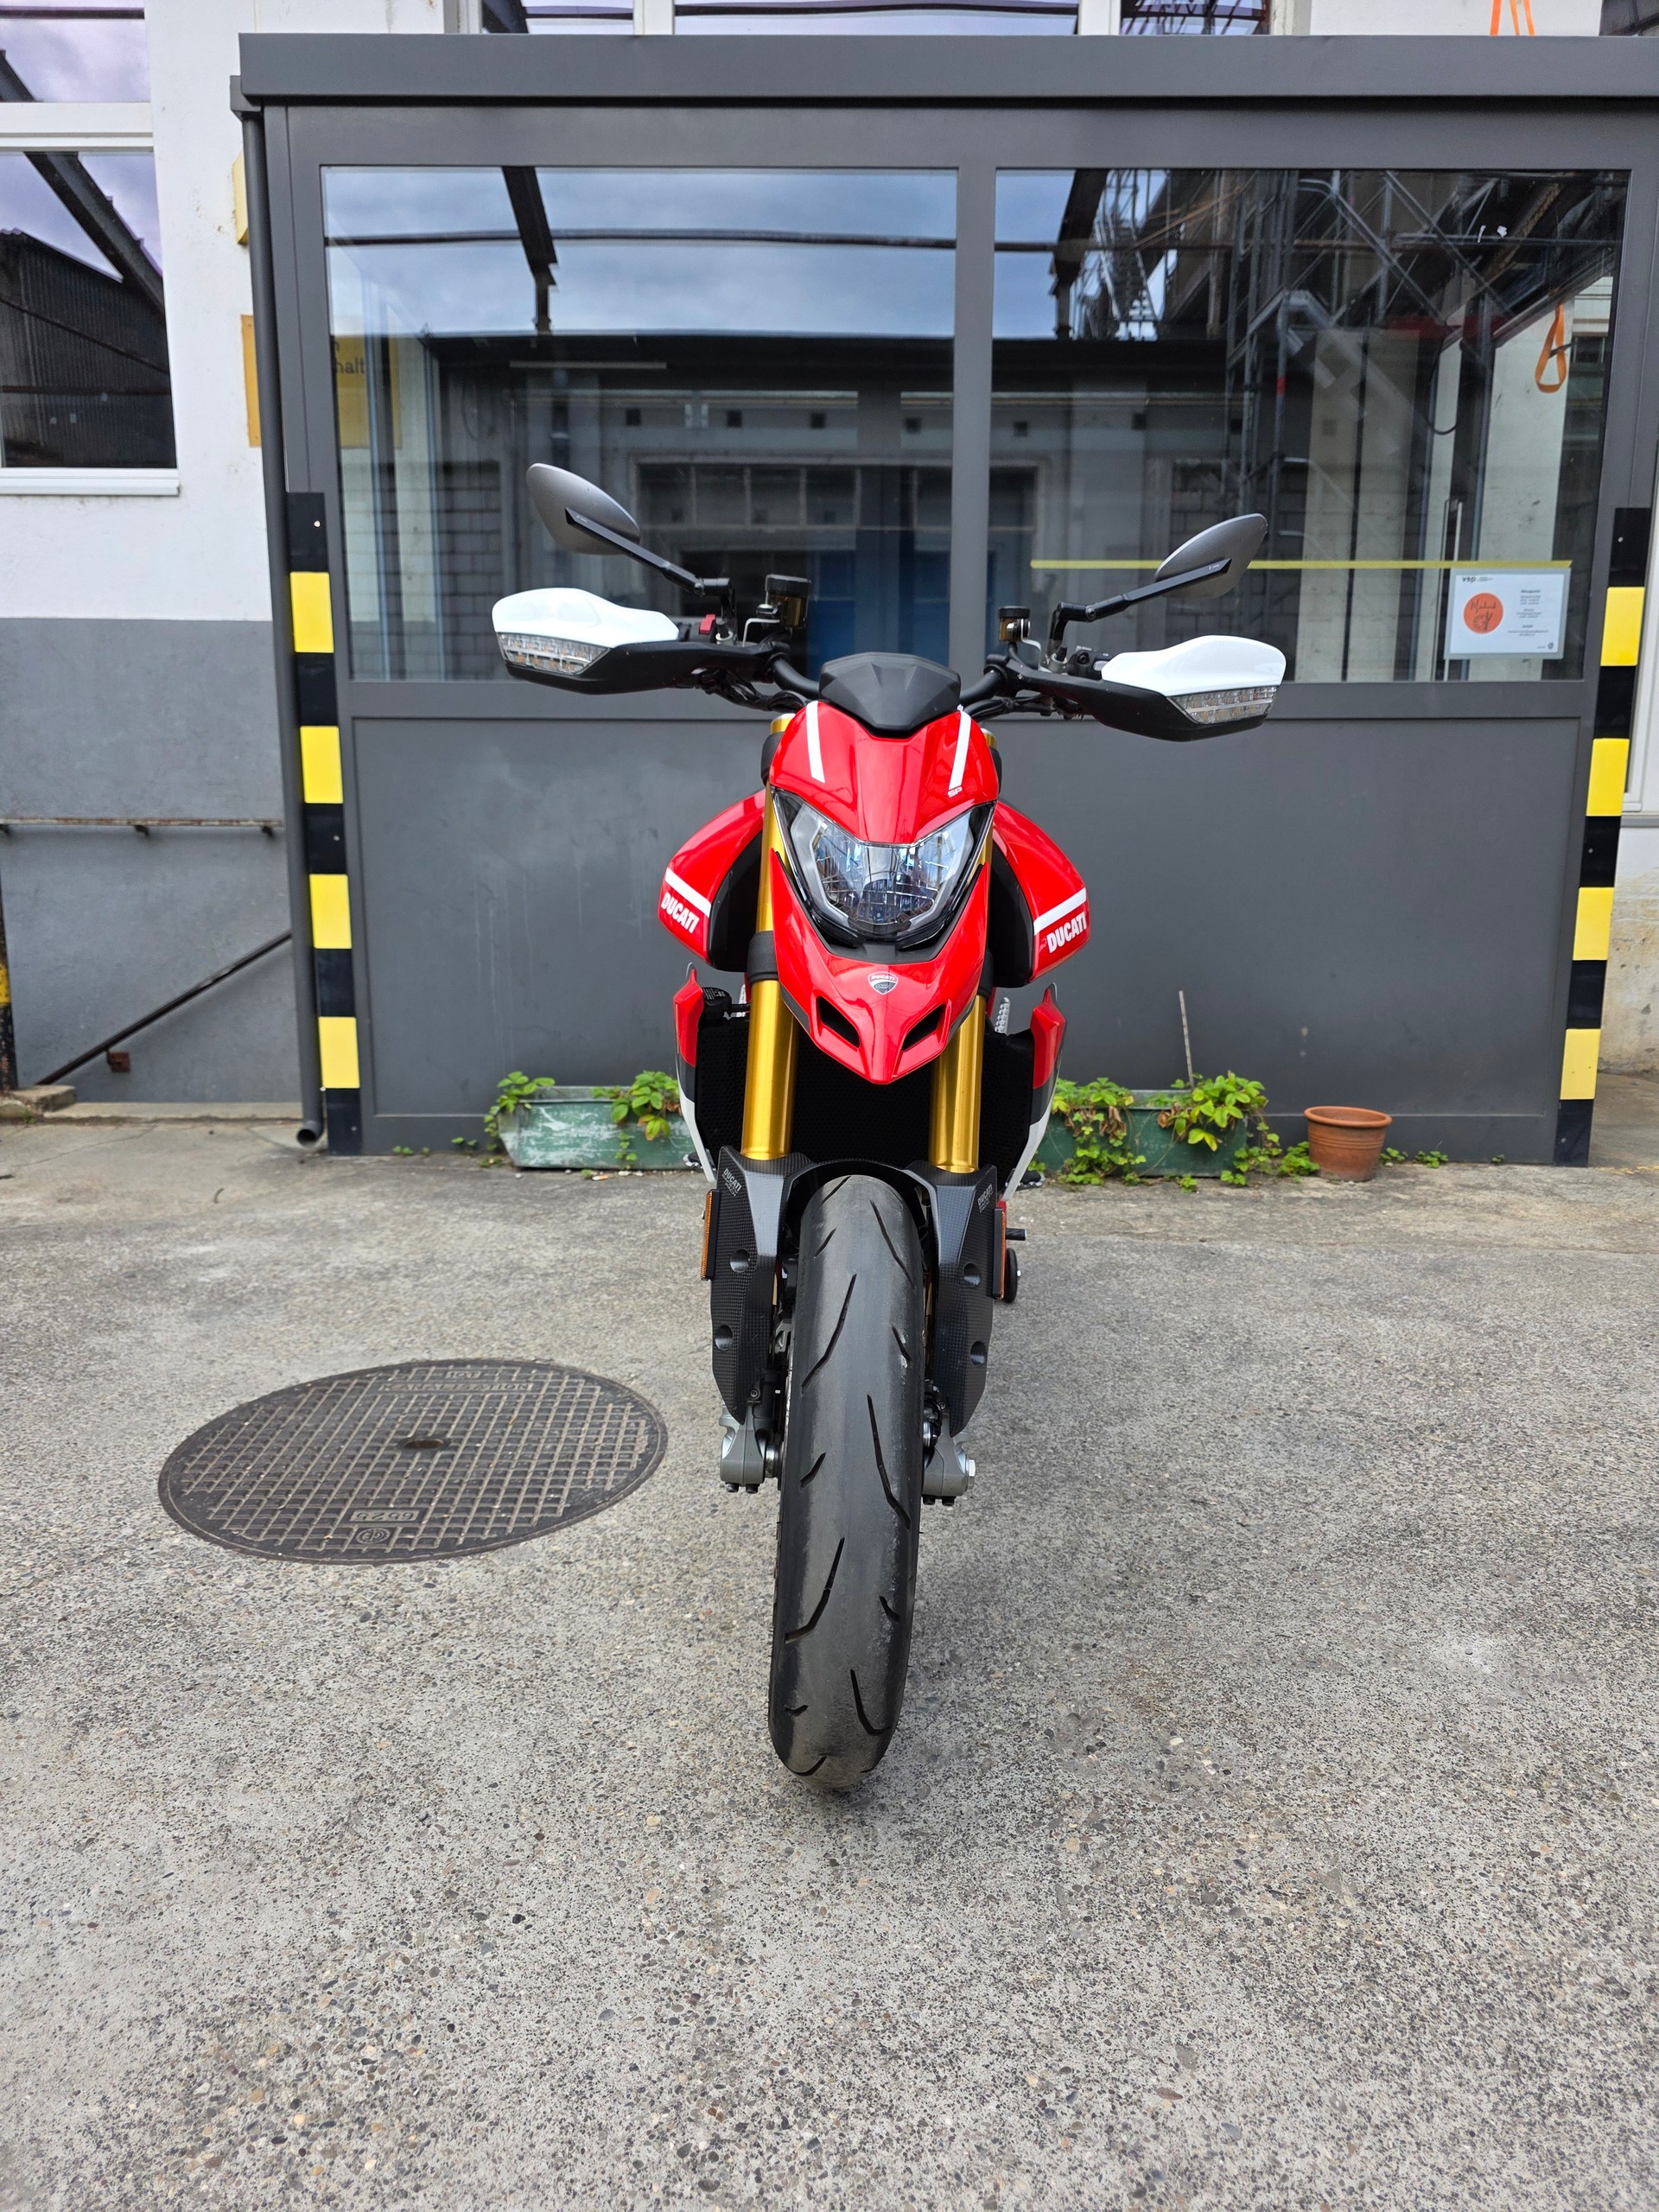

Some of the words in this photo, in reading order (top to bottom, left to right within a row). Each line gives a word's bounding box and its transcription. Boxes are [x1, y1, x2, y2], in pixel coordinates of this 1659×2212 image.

[948, 786, 963, 798] SP
[660, 892, 700, 934] DUCATI
[1046, 911, 1087, 954] DUCATI
[723, 1167, 742, 1192] DUCATI
[977, 1184, 993, 1206] DUCATI
